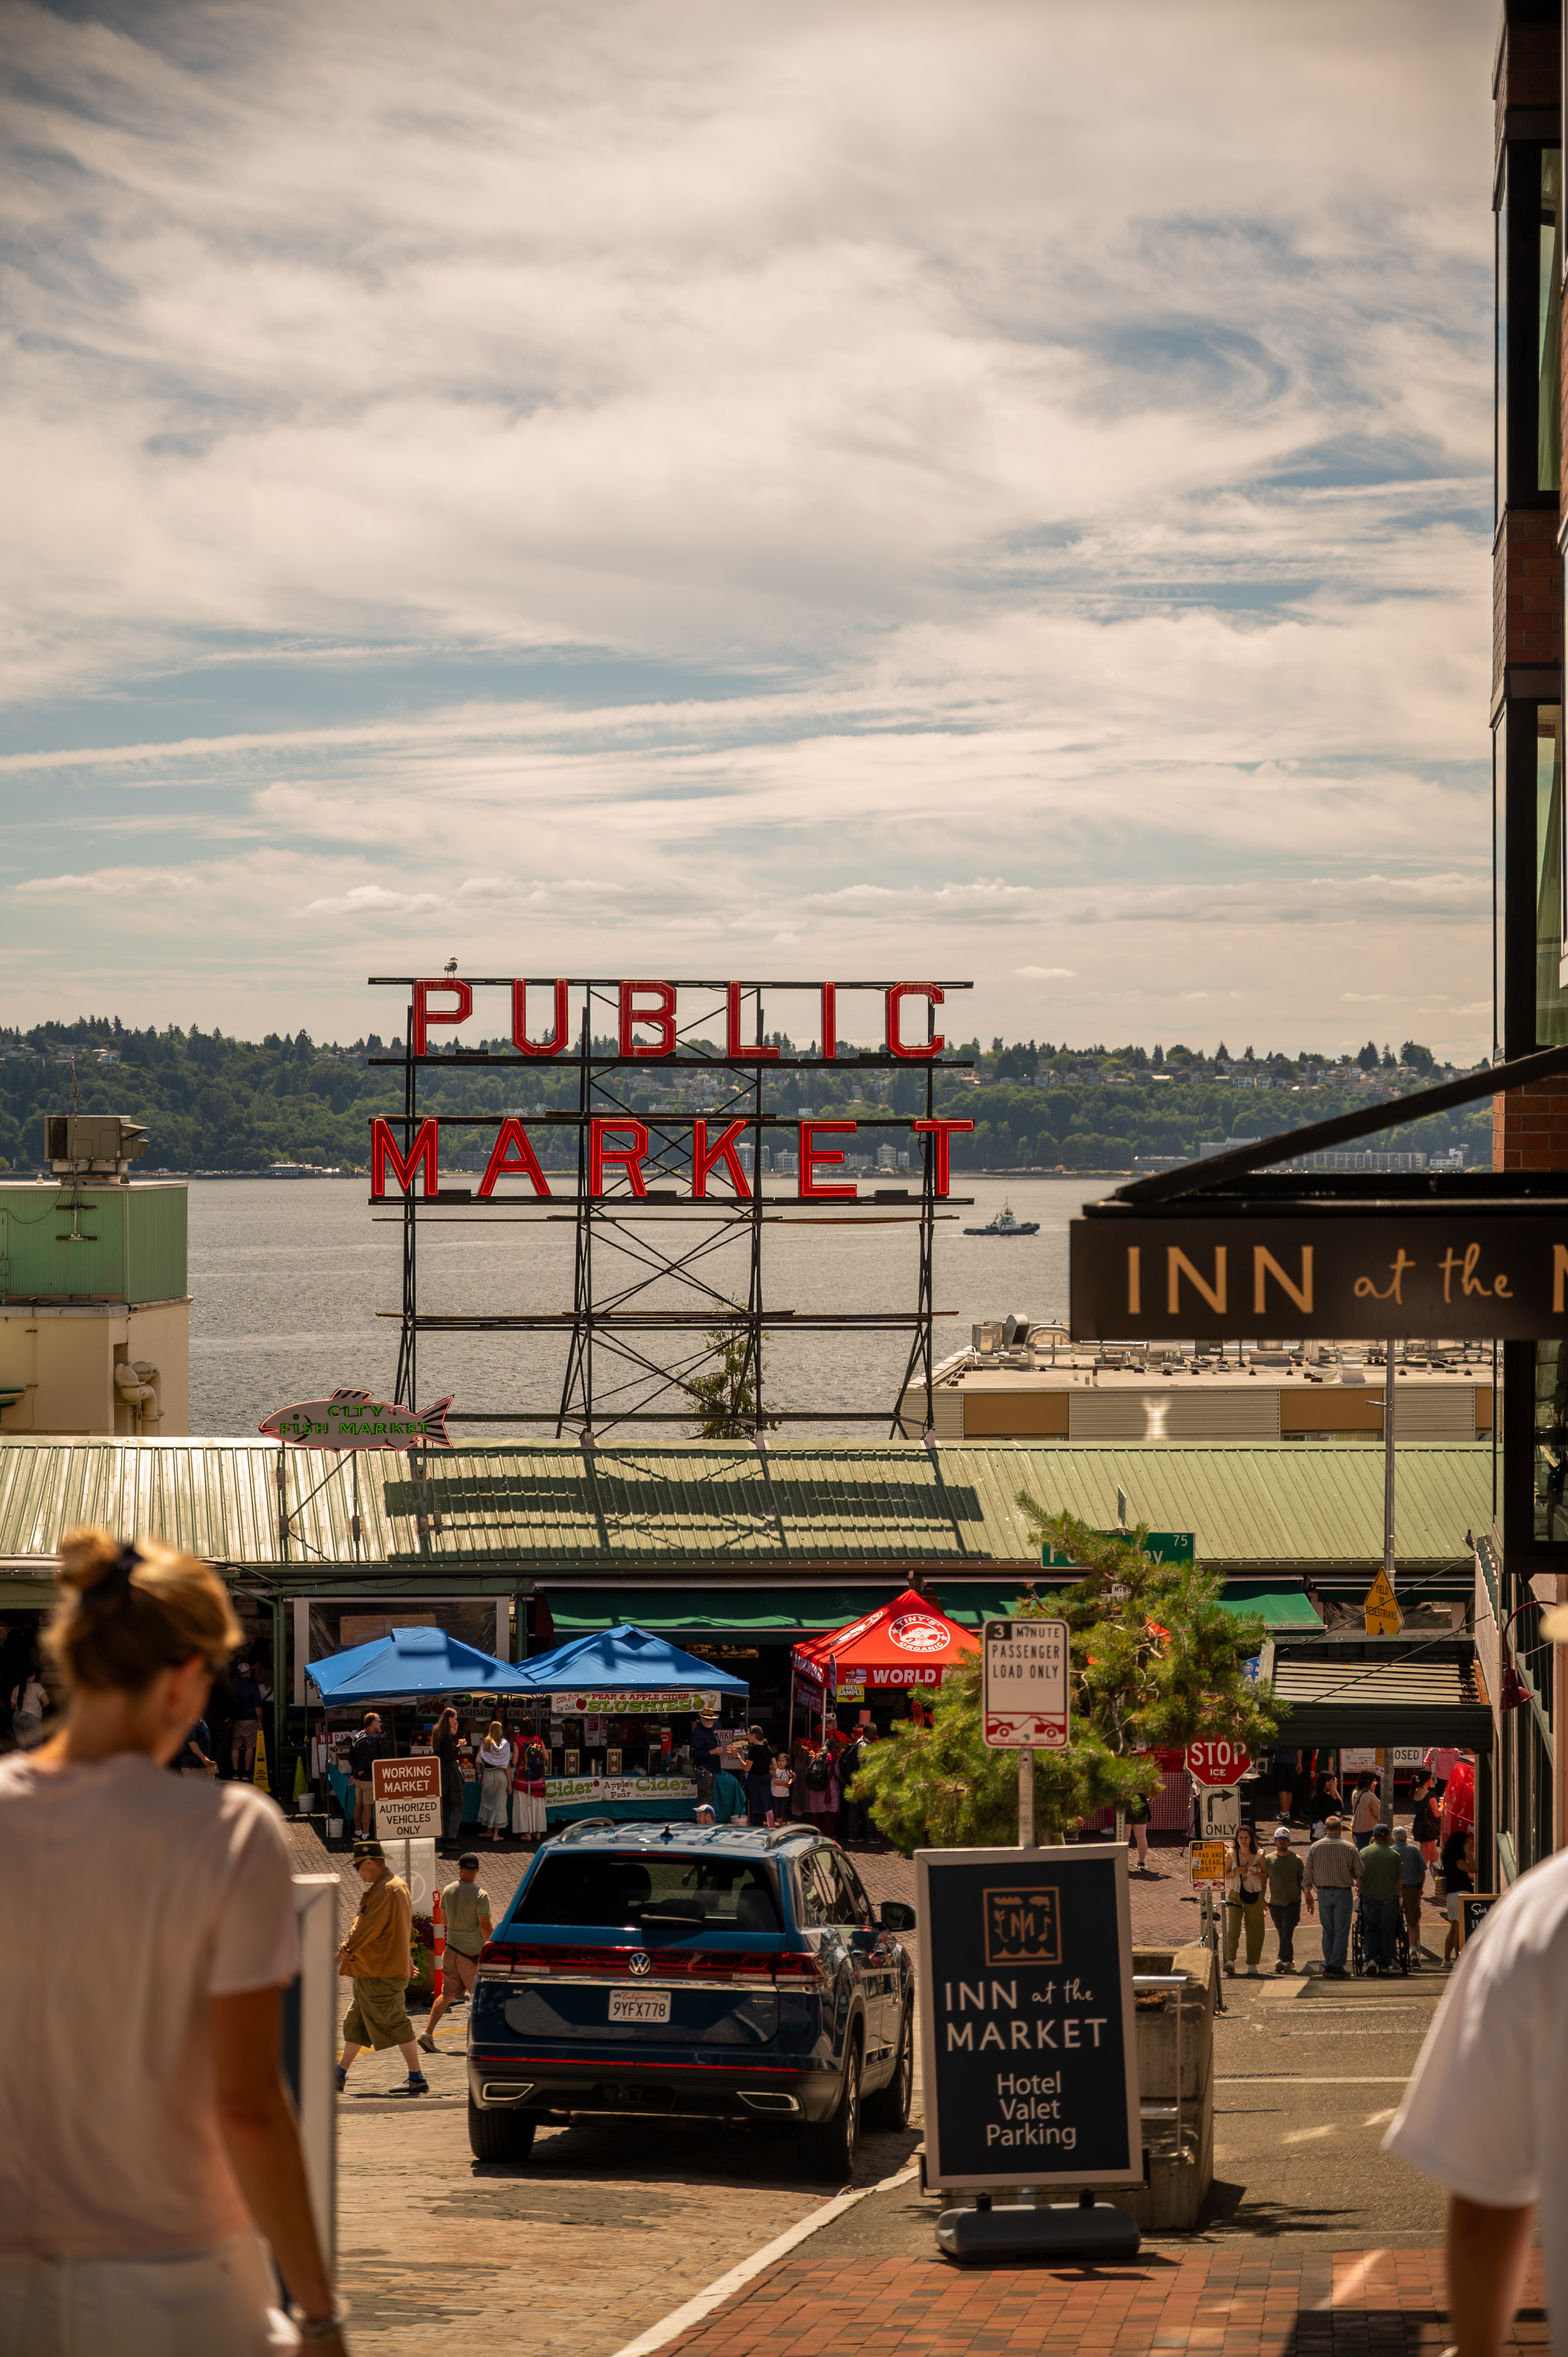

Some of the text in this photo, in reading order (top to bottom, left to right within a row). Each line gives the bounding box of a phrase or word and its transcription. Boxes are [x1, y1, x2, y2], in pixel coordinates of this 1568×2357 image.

[413, 979, 945, 1058] PUBLIC
[371, 1117, 974, 1197] MARKET
[1128, 1246, 1314, 1314] INN
[1353, 1249, 1416, 1305] at
[1437, 1242, 1513, 1304] the
[327, 1405, 385, 1418] CITY
[280, 1422, 429, 1435] FISH MARKET
[1173, 1534, 1188, 1547] 75
[1376, 1585, 1389, 1595] YIELD
[1379, 1597, 1385, 1606] TO
[1366, 1605, 1398, 1621] PEDESTRIANS
[896, 1616, 937, 1626] TINY'S
[994, 1624, 1005, 1638] 3
[899, 1642, 943, 1651] ORGANIC
[992, 1645, 1059, 1659] PASSENGER
[873, 1669, 936, 1684] WORLD
[993, 1665, 1058, 1679] LOAD ONLY
[556, 1695, 567, 1704] 100%
[587, 1699, 692, 1712] SLUSHIES
[1190, 1741, 1247, 1766] STOP
[381, 1765, 432, 1780] WORKING
[384, 1779, 430, 1793] MARKET
[545, 1780, 593, 1797] Cider
[604, 1781, 629, 1791] Apple
[636, 1778, 690, 1792] Cider
[379, 1802, 437, 1814] AUTHORIZED
[386, 1814, 431, 1825] VEHICLES
[397, 1825, 421, 1835] ONLY
[1206, 1824, 1237, 1835] ONLY
[622, 1992, 659, 2002] California
[945, 1977, 1094, 2011] INN at the
[613, 2002, 666, 2018] 9YFX778
[947, 2018, 1108, 2052] MARKET
[997, 2071, 1061, 2095] Hotel
[1000, 2098, 1061, 2120] Valet
[986, 2123, 1077, 2150] Parking
